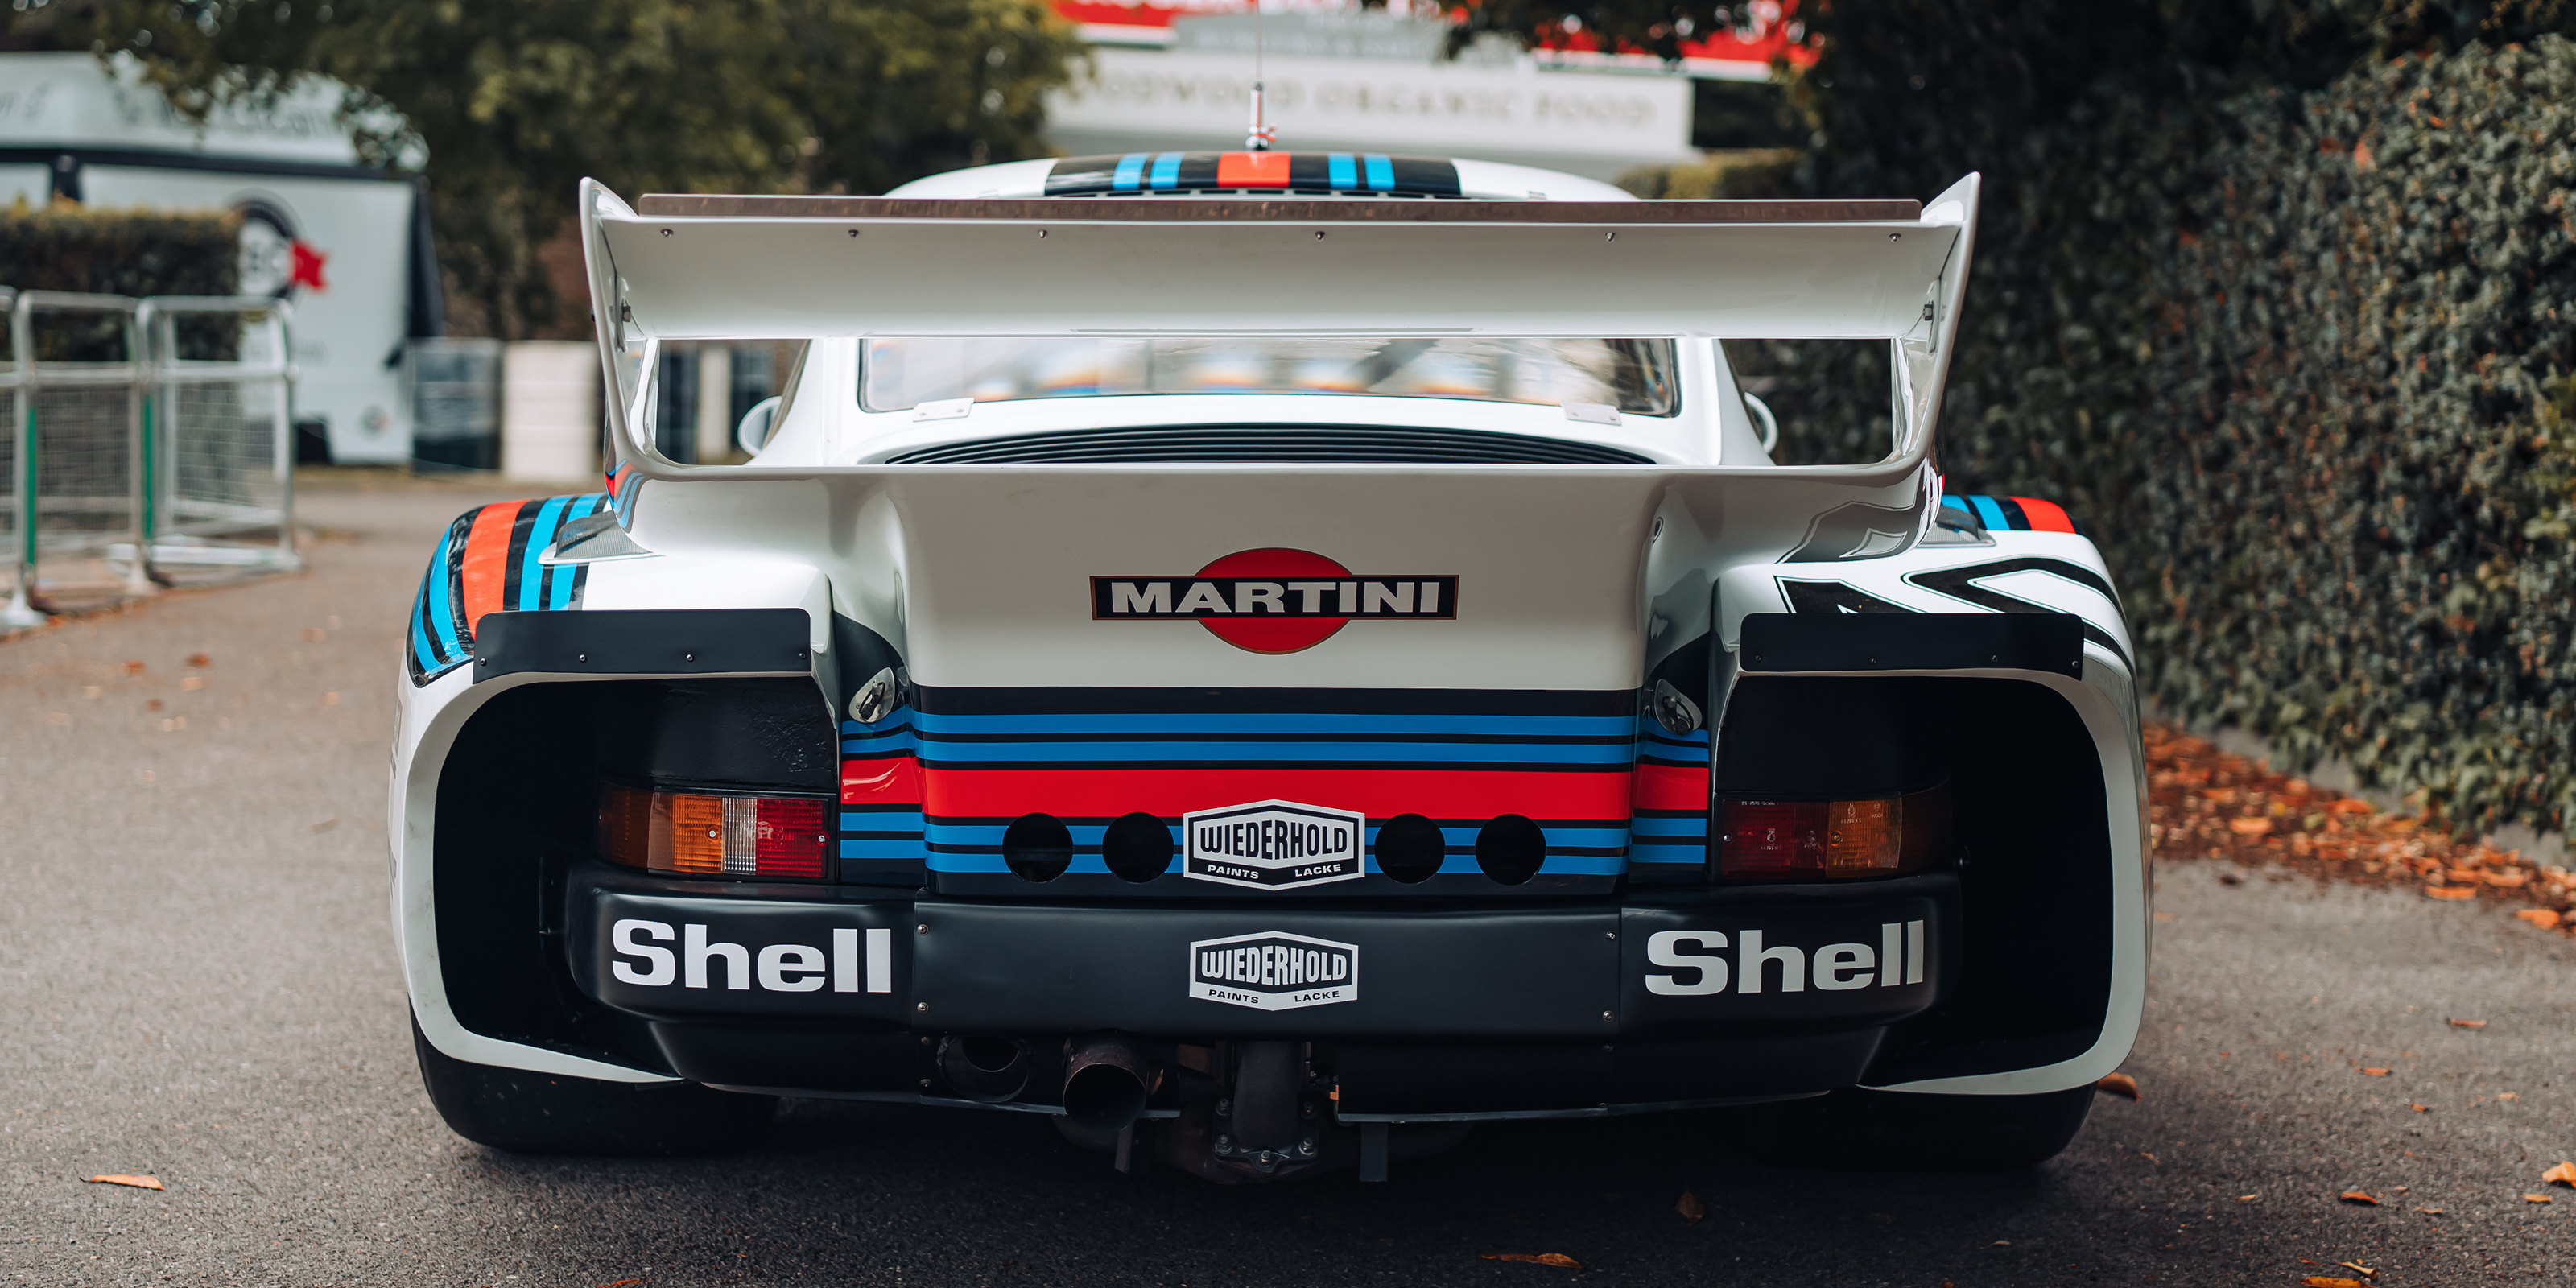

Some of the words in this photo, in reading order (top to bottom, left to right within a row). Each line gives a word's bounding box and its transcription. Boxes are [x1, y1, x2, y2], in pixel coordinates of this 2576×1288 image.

[1533, 90, 1654, 131] FOOD
[1111, 581, 1439, 613] MARTINI
[1199, 819, 1348, 861] WIEDERHOLD
[1207, 864, 1260, 879] PAINTS
[1294, 864, 1342, 877] LACKE
[612, 919, 891, 993] Shell
[1201, 945, 1348, 986] WIEDERHOLD
[1645, 919, 1924, 996] Shell
[1208, 989, 1260, 1004] PAINTS
[1294, 990, 1340, 1002] LACKE
